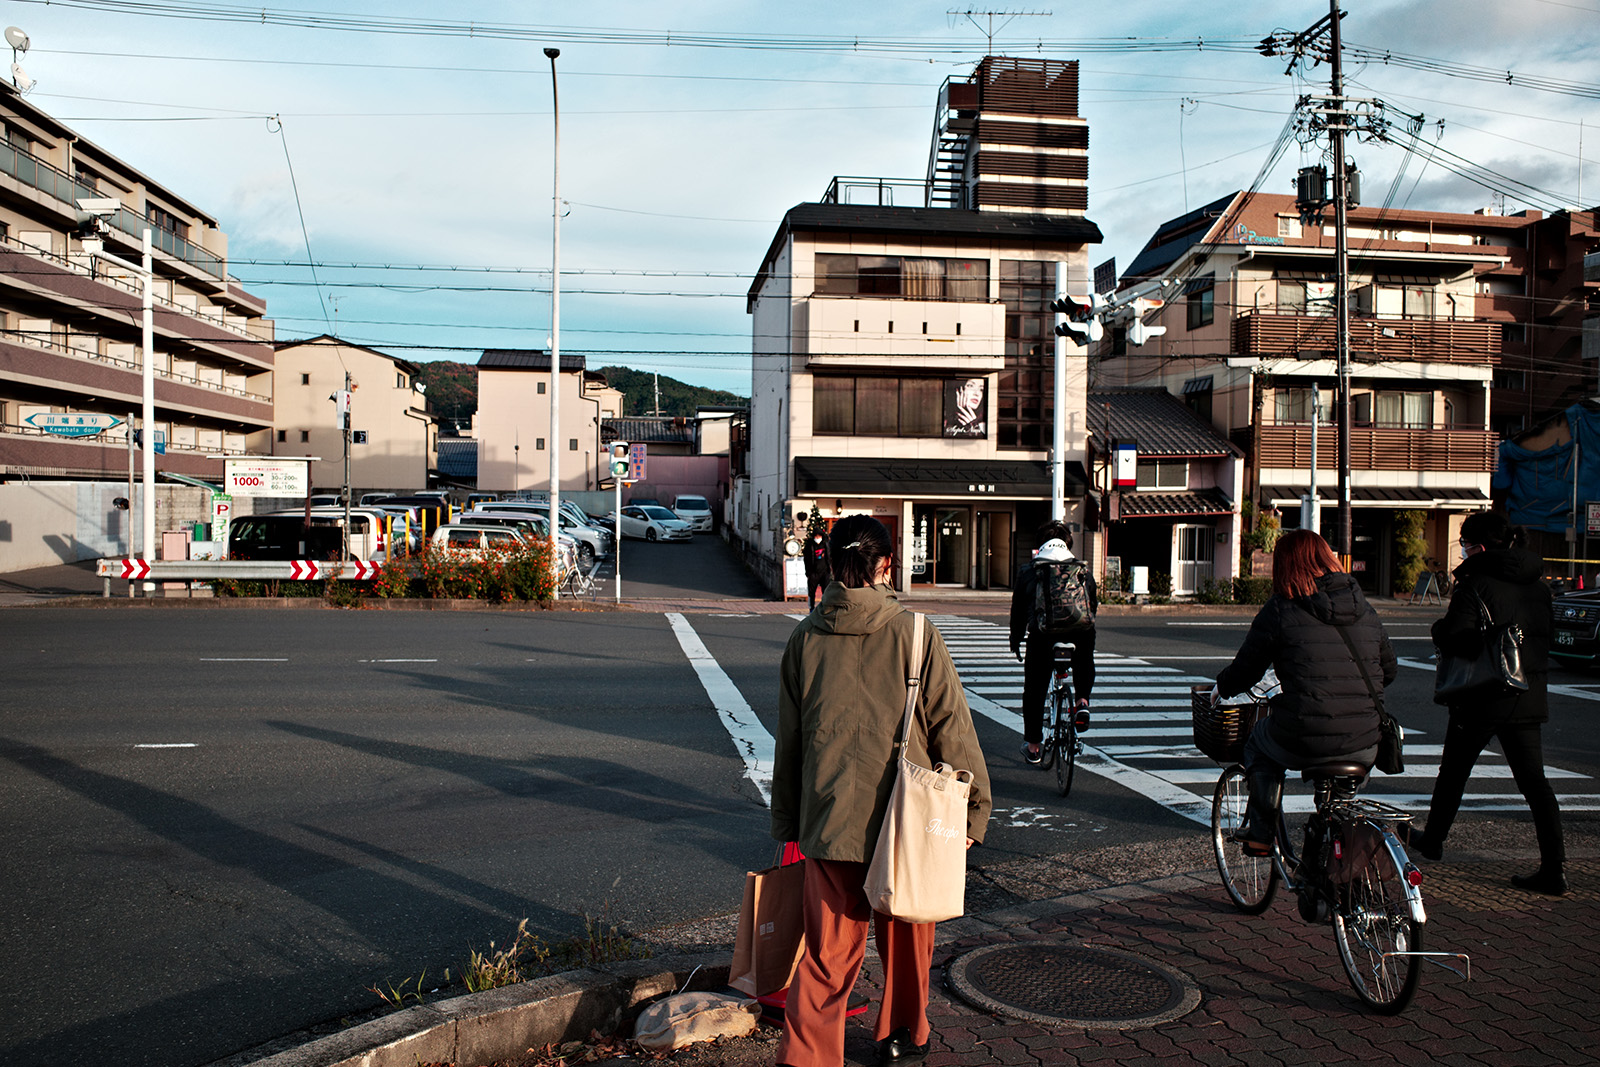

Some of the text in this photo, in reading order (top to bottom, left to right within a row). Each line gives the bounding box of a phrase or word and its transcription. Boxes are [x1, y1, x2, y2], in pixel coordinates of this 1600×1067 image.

[46, 417, 98, 425] 川端通り
[217, 504, 229, 515] P
